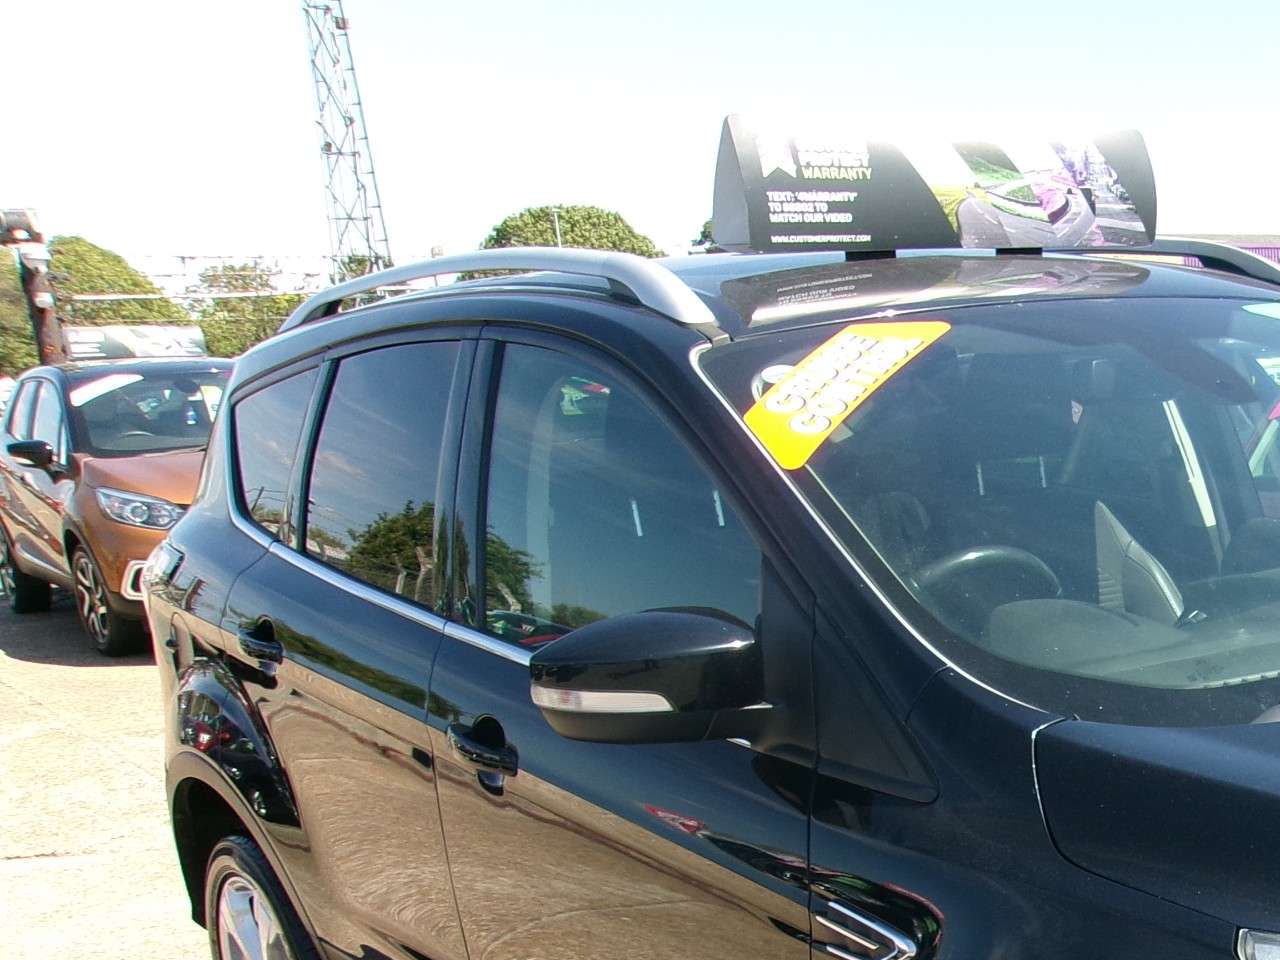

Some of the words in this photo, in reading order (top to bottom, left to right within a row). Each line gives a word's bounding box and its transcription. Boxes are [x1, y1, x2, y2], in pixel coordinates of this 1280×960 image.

[801, 166, 872, 180] WARRANTY
[769, 212, 803, 223] WATCH
[803, 212, 824, 223] OUR
[824, 212, 853, 223] VIDEO
